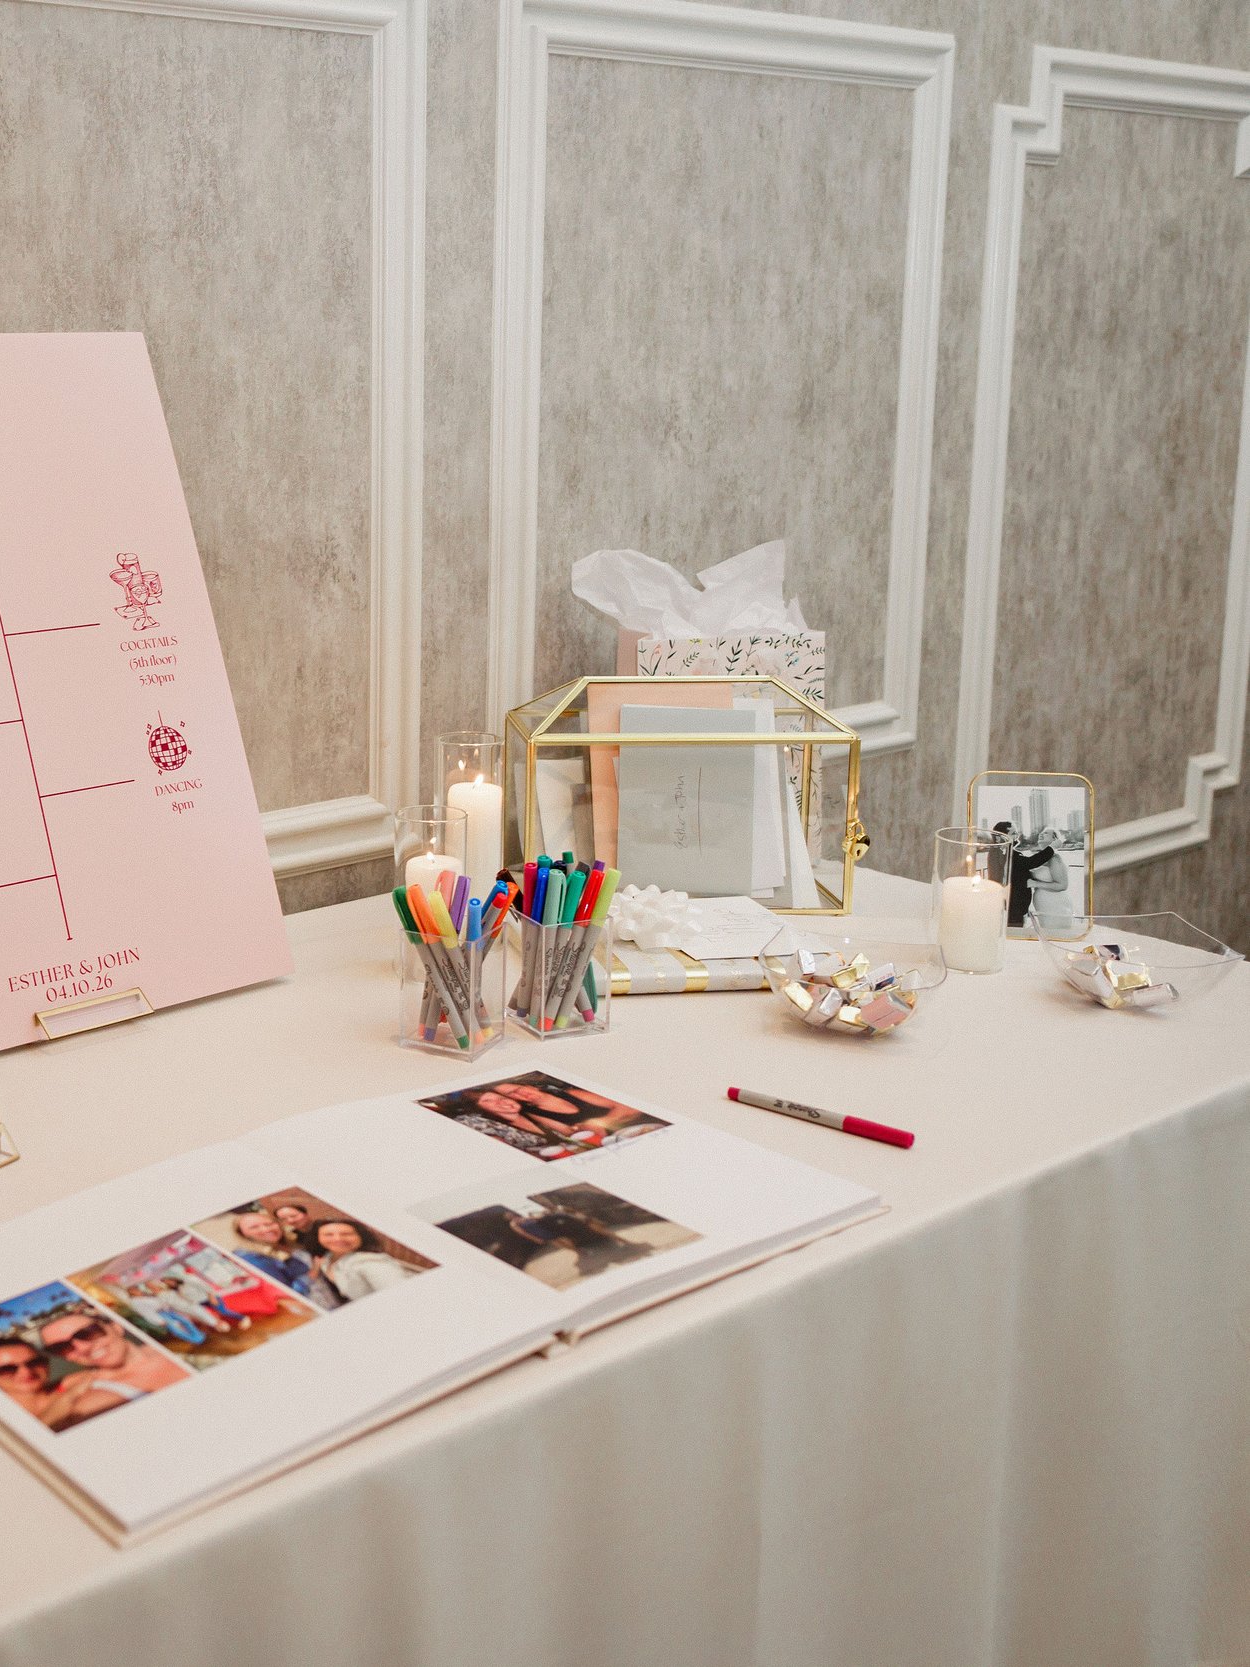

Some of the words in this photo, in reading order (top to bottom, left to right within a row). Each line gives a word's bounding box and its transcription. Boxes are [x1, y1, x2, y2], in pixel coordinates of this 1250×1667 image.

[119, 635, 178, 652] COCKTAILS
[129, 656, 149, 671] (5th
[149, 654, 178, 668] floor)
[139, 673, 175, 687] 5:30pm
[154, 779, 203, 797] DANCING
[171, 800, 195, 815] 8pm
[7, 963, 75, 993] ESTHER
[79, 959, 93, 976] &
[95, 947, 140, 974] JOHN
[45, 972, 113, 1003] 04.10.26
